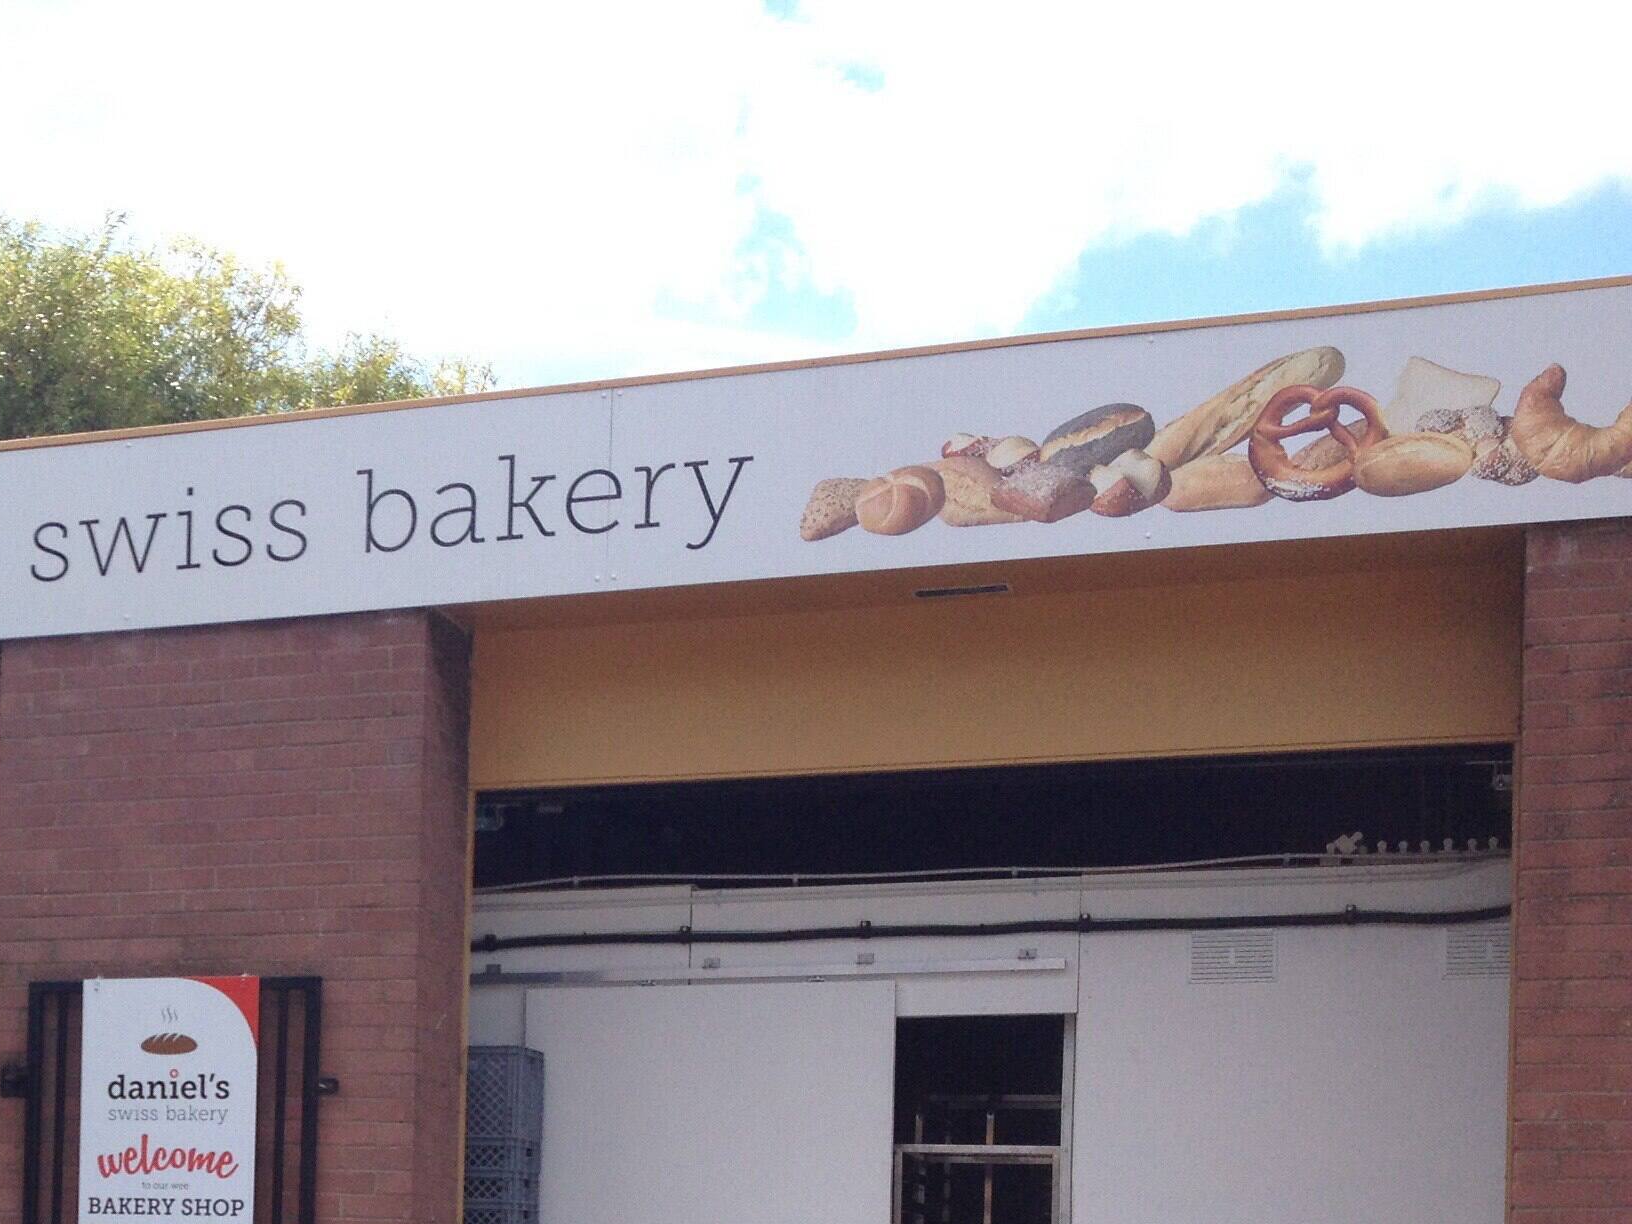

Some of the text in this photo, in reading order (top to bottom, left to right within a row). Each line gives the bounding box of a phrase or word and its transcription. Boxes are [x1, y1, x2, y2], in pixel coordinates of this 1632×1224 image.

[29, 486, 309, 584] swiss
[356, 455, 755, 553] bakery
[108, 1069, 230, 1100] daniel's
[108, 1104, 229, 1125] swiss bakery
[97, 1133, 239, 1179] welcome
[88, 1197, 244, 1217] BAKERY SHOP
